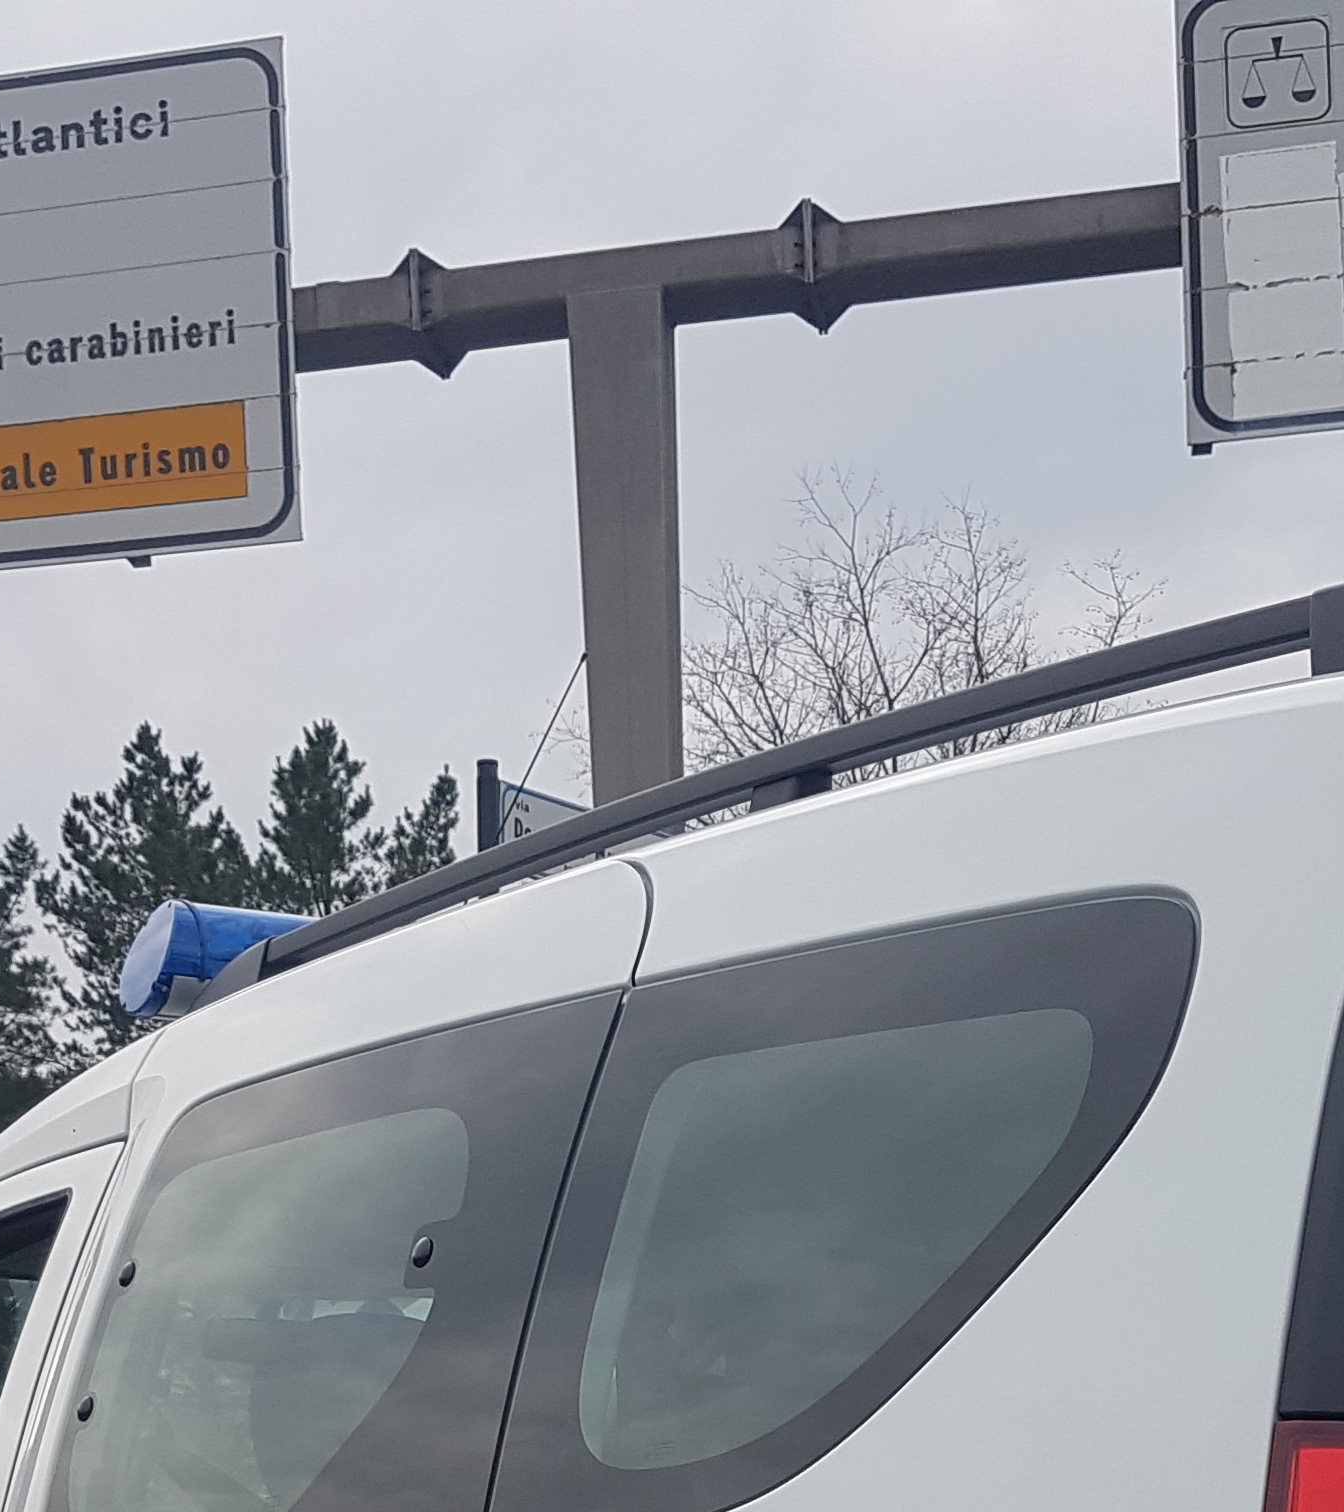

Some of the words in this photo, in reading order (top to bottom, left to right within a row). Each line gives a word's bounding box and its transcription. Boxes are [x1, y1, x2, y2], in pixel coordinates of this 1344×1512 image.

[24, 308, 238, 370] carabinieri
[78, 436, 232, 484] Turismo
[514, 799, 530, 813] via
